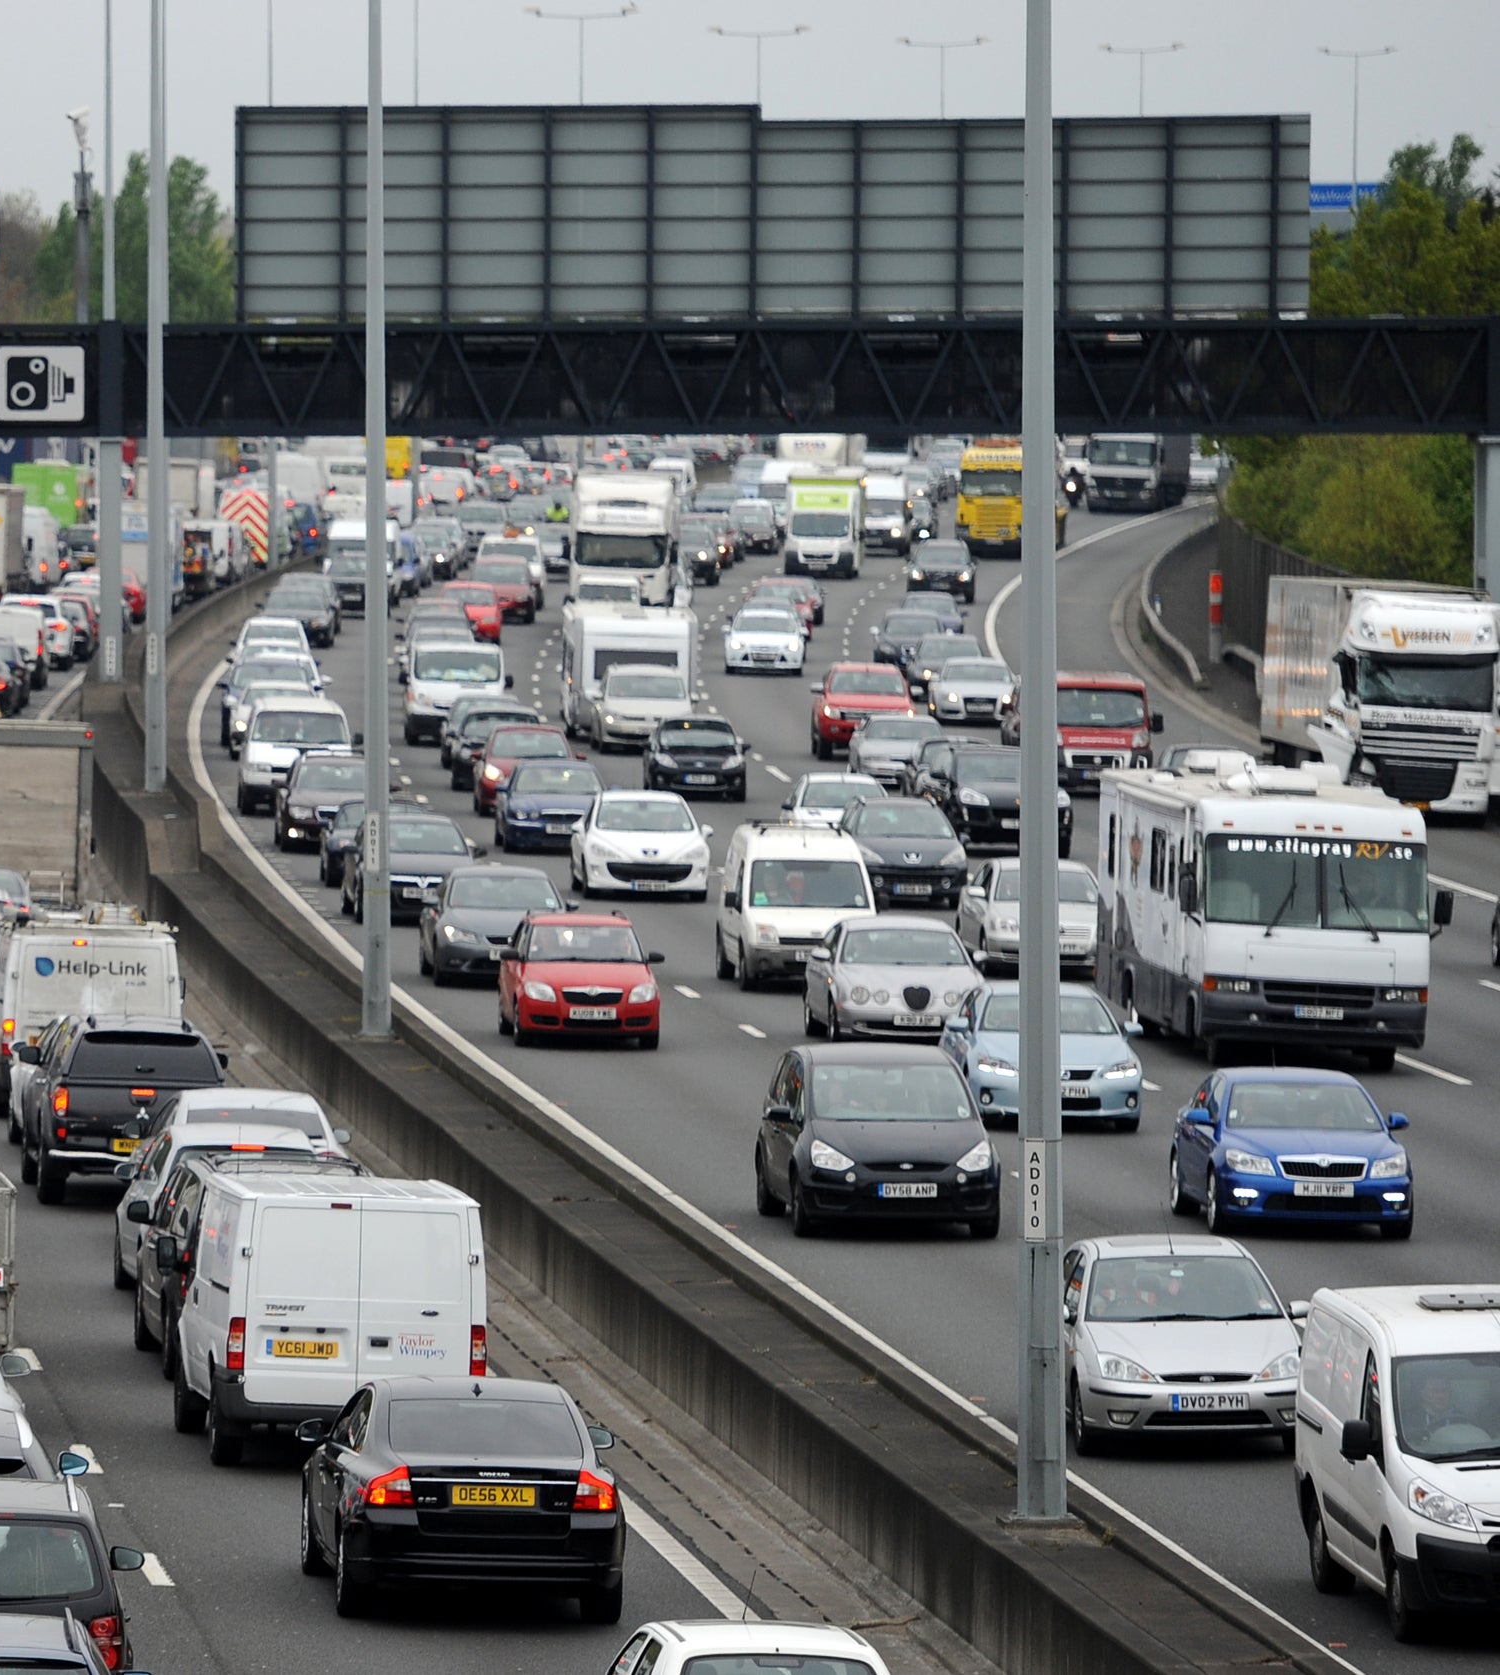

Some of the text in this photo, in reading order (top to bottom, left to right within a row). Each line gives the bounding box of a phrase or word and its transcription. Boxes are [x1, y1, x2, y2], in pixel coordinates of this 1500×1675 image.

[58, 959, 148, 978] Help-Link
[1028, 1151, 1041, 1229] AD010
[265, 1303, 305, 1312] TRANSIT
[277, 1340, 334, 1356] YC61 JWD
[399, 1335, 435, 1348] Taylor
[399, 1346, 448, 1360] Wimpey
[1181, 1395, 1244, 1409] DV02 PYH
[459, 1487, 529, 1503] OE56 XXL
